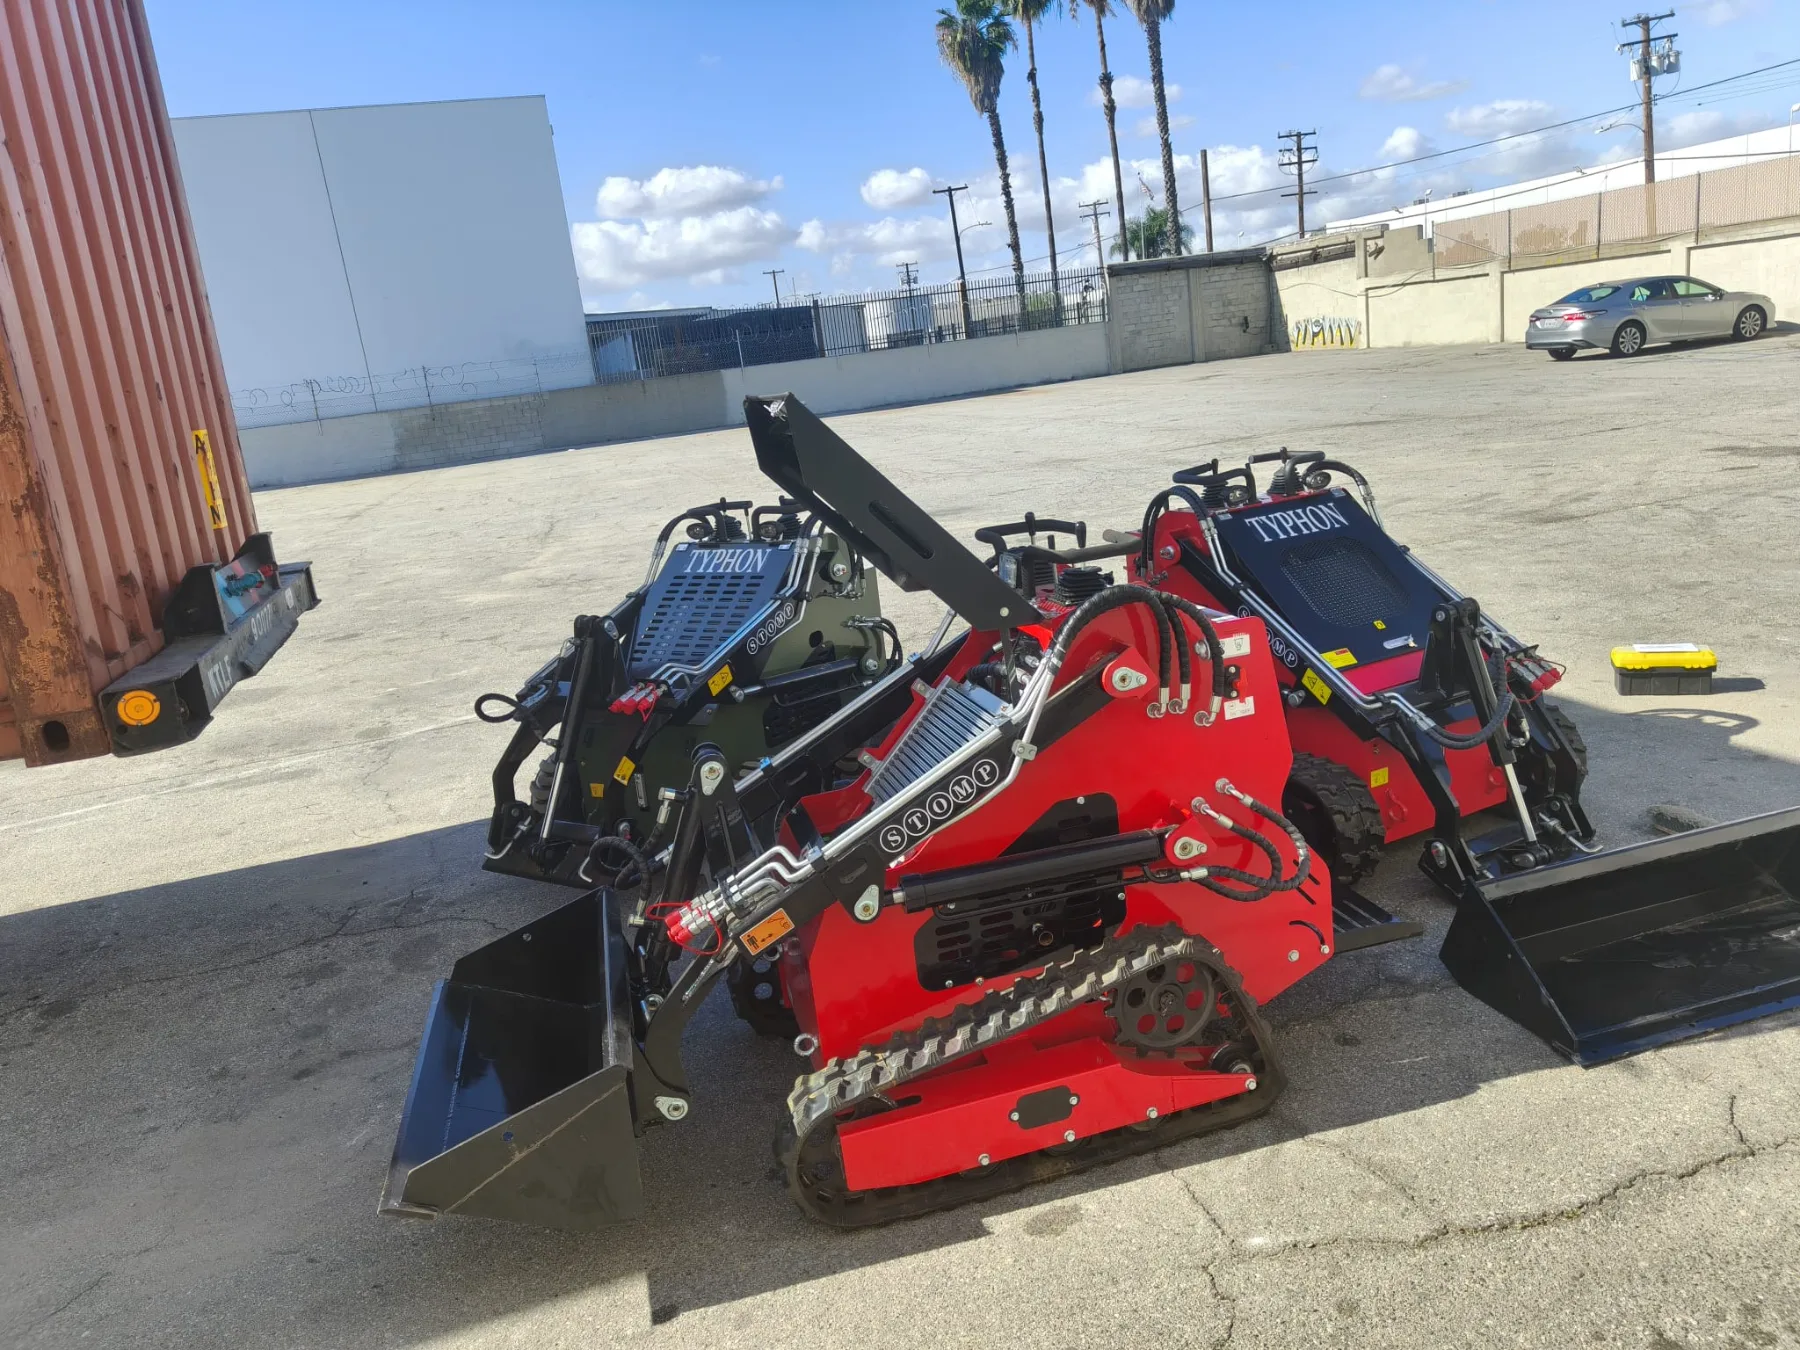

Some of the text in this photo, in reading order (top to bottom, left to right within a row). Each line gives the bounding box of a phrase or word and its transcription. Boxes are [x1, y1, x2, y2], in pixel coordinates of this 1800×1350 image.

[1244, 502, 1349, 542] TYPHON
[684, 548, 772, 573] TYPHON
[748, 604, 793, 653] STOMP
[1238, 607, 1297, 666] SMP
[881, 760, 997, 852] STOMP
